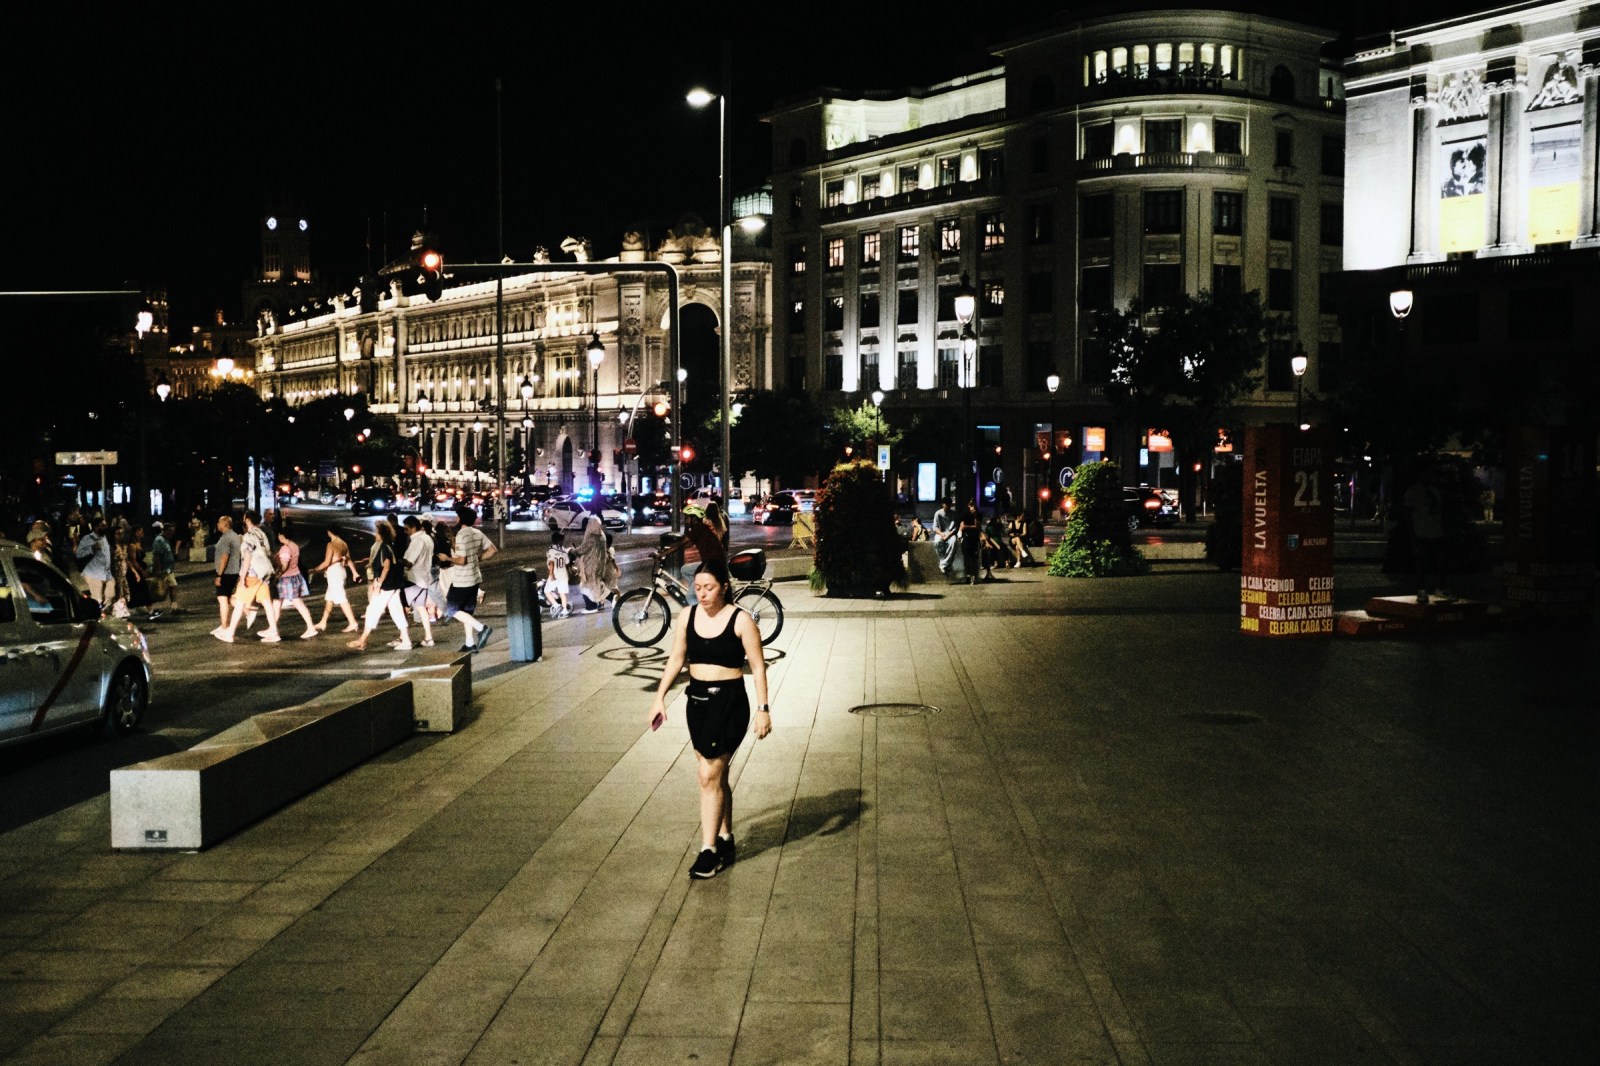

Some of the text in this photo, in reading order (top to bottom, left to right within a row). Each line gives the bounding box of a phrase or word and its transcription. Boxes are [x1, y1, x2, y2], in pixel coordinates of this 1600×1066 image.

[1293, 448, 1322, 466] ETAPA
[1294, 470, 1321, 507] 21
[1254, 470, 1267, 527] VUELTA
[1254, 530, 1267, 549] LA
[1248, 577, 1263, 590] CADA
[1264, 578, 1294, 592] SEGUNDO
[1278, 592, 1310, 606] CELEBRA
[1311, 591, 1331, 604] CADA
[1259, 605, 1286, 620] CELEBRA
[1287, 606, 1307, 620] CADA
[1269, 620, 1299, 635] CELEBRA
[1300, 619, 1320, 634] CADA
